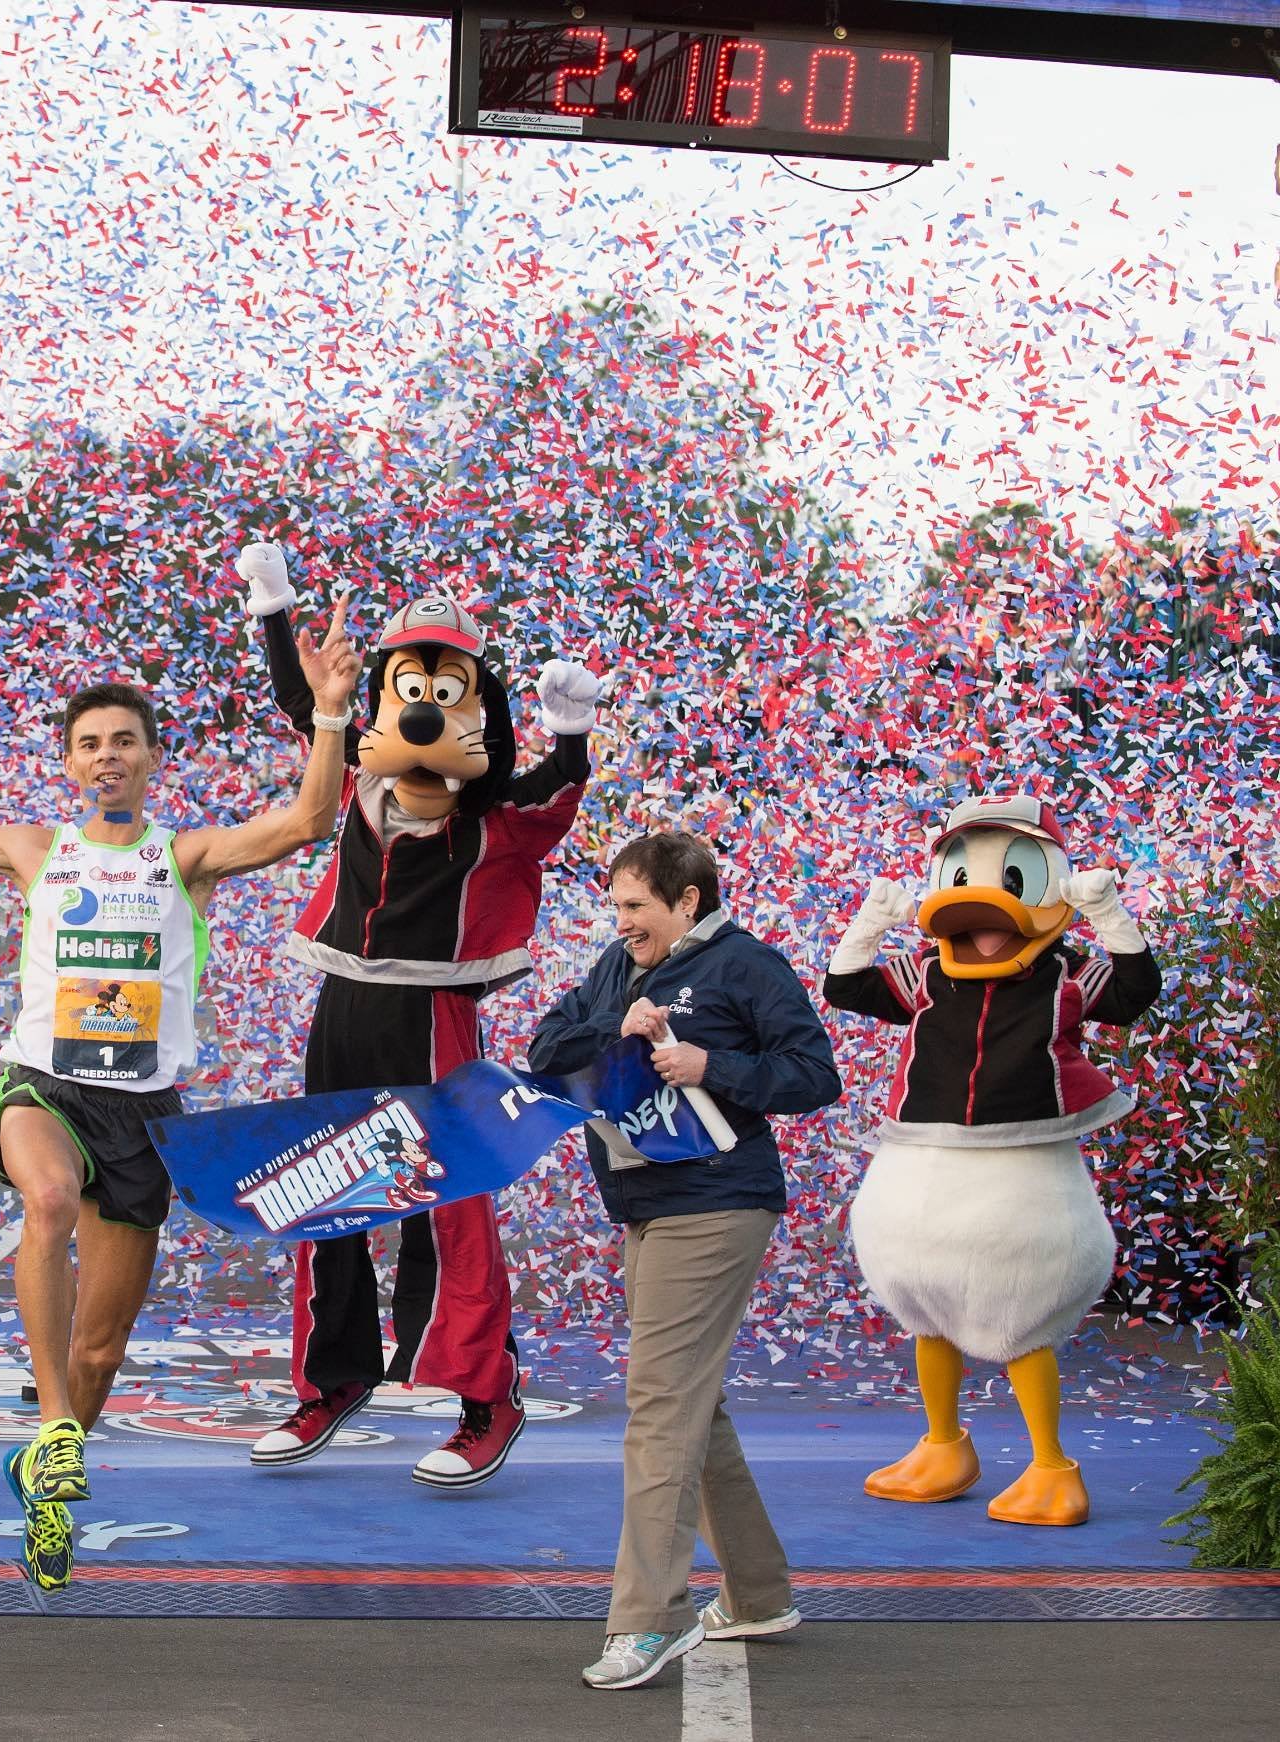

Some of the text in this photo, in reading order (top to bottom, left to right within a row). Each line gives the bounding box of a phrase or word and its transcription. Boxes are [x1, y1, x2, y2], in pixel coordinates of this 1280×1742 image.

[480, 112, 543, 123] Raceclock
[103, 893, 160, 906] NATURAL
[103, 905, 161, 915] ENERGIA
[59, 936, 139, 959] Heliar
[668, 1003, 693, 1015] Cigna
[99, 1046, 114, 1067] 1
[72, 1068, 139, 1079] FREDISON
[373, 1089, 393, 1106] 2015
[235, 1123, 336, 1193] WALT DISNEY WORLD
[238, 1099, 426, 1232] MARATHON
[345, 1215, 371, 1226] Cigna
